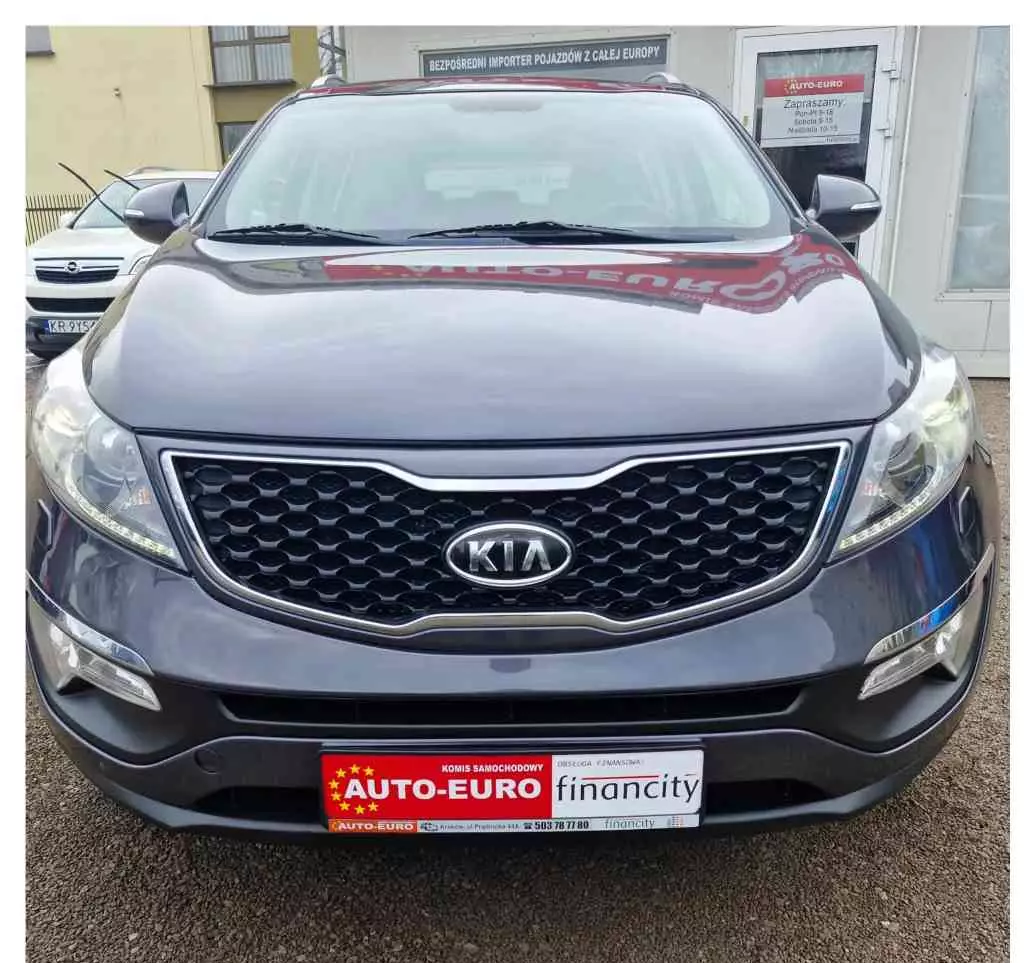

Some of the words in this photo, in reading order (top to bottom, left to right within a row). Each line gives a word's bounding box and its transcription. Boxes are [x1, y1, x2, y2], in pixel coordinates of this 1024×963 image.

[429, 56, 487, 72] BEZPOŚREDNI
[488, 55, 532, 69] IMPORTER
[534, 50, 583, 65] POJAZDÓW
[584, 52, 591, 62] Z
[592, 48, 620, 61] CAŁEJ
[623, 45, 660, 59] EUROPY
[789, 80, 844, 90] AUTO-EURO
[49, 321, 66, 332] KR
[467, 540, 552, 572] KIA
[441, 764, 471, 773] KOMIS
[473, 763, 544, 773] SAMOCHODOWY
[343, 777, 542, 800] AUTO-EURO
[555, 773, 699, 803] financity
[338, 822, 414, 831] AUTO-EURO
[534, 820, 552, 830] 503
[554, 820, 565, 830] 78
[566, 820, 576, 830] 77
[577, 820, 589, 830] 80
[604, 817, 655, 829] financity
